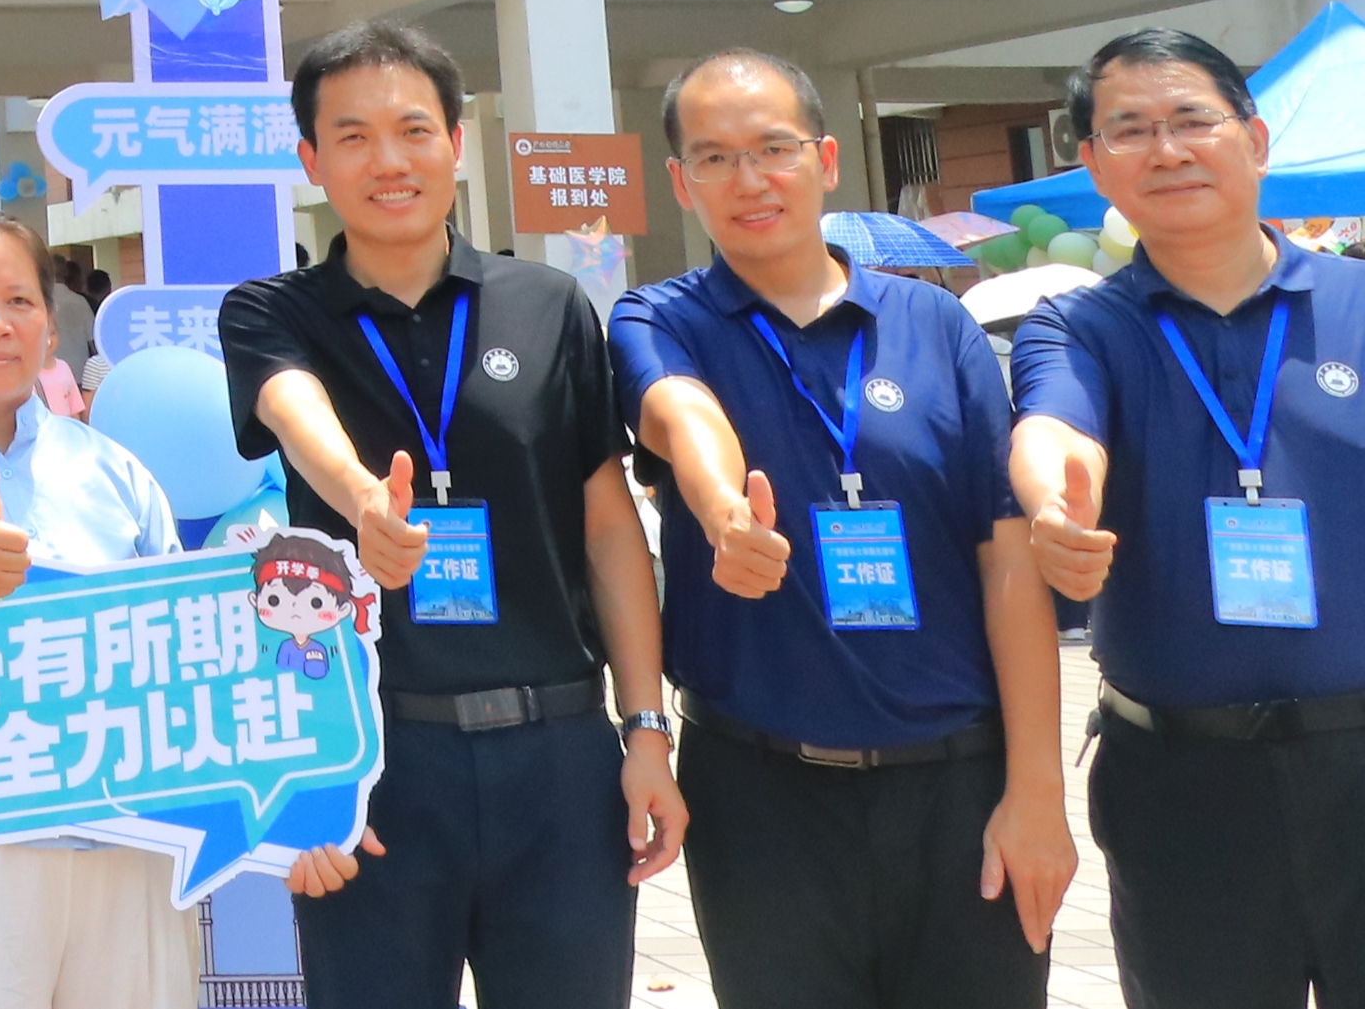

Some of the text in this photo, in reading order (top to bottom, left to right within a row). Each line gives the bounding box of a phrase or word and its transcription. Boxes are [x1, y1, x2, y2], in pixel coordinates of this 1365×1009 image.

[92, 103, 299, 159] 元气满满
[529, 165, 627, 186] 基础医学院
[550, 188, 609, 207] 报到处
[424, 558, 480, 581] 工作证
[837, 562, 896, 584] 工作证
[1229, 558, 1293, 582] 工作证
